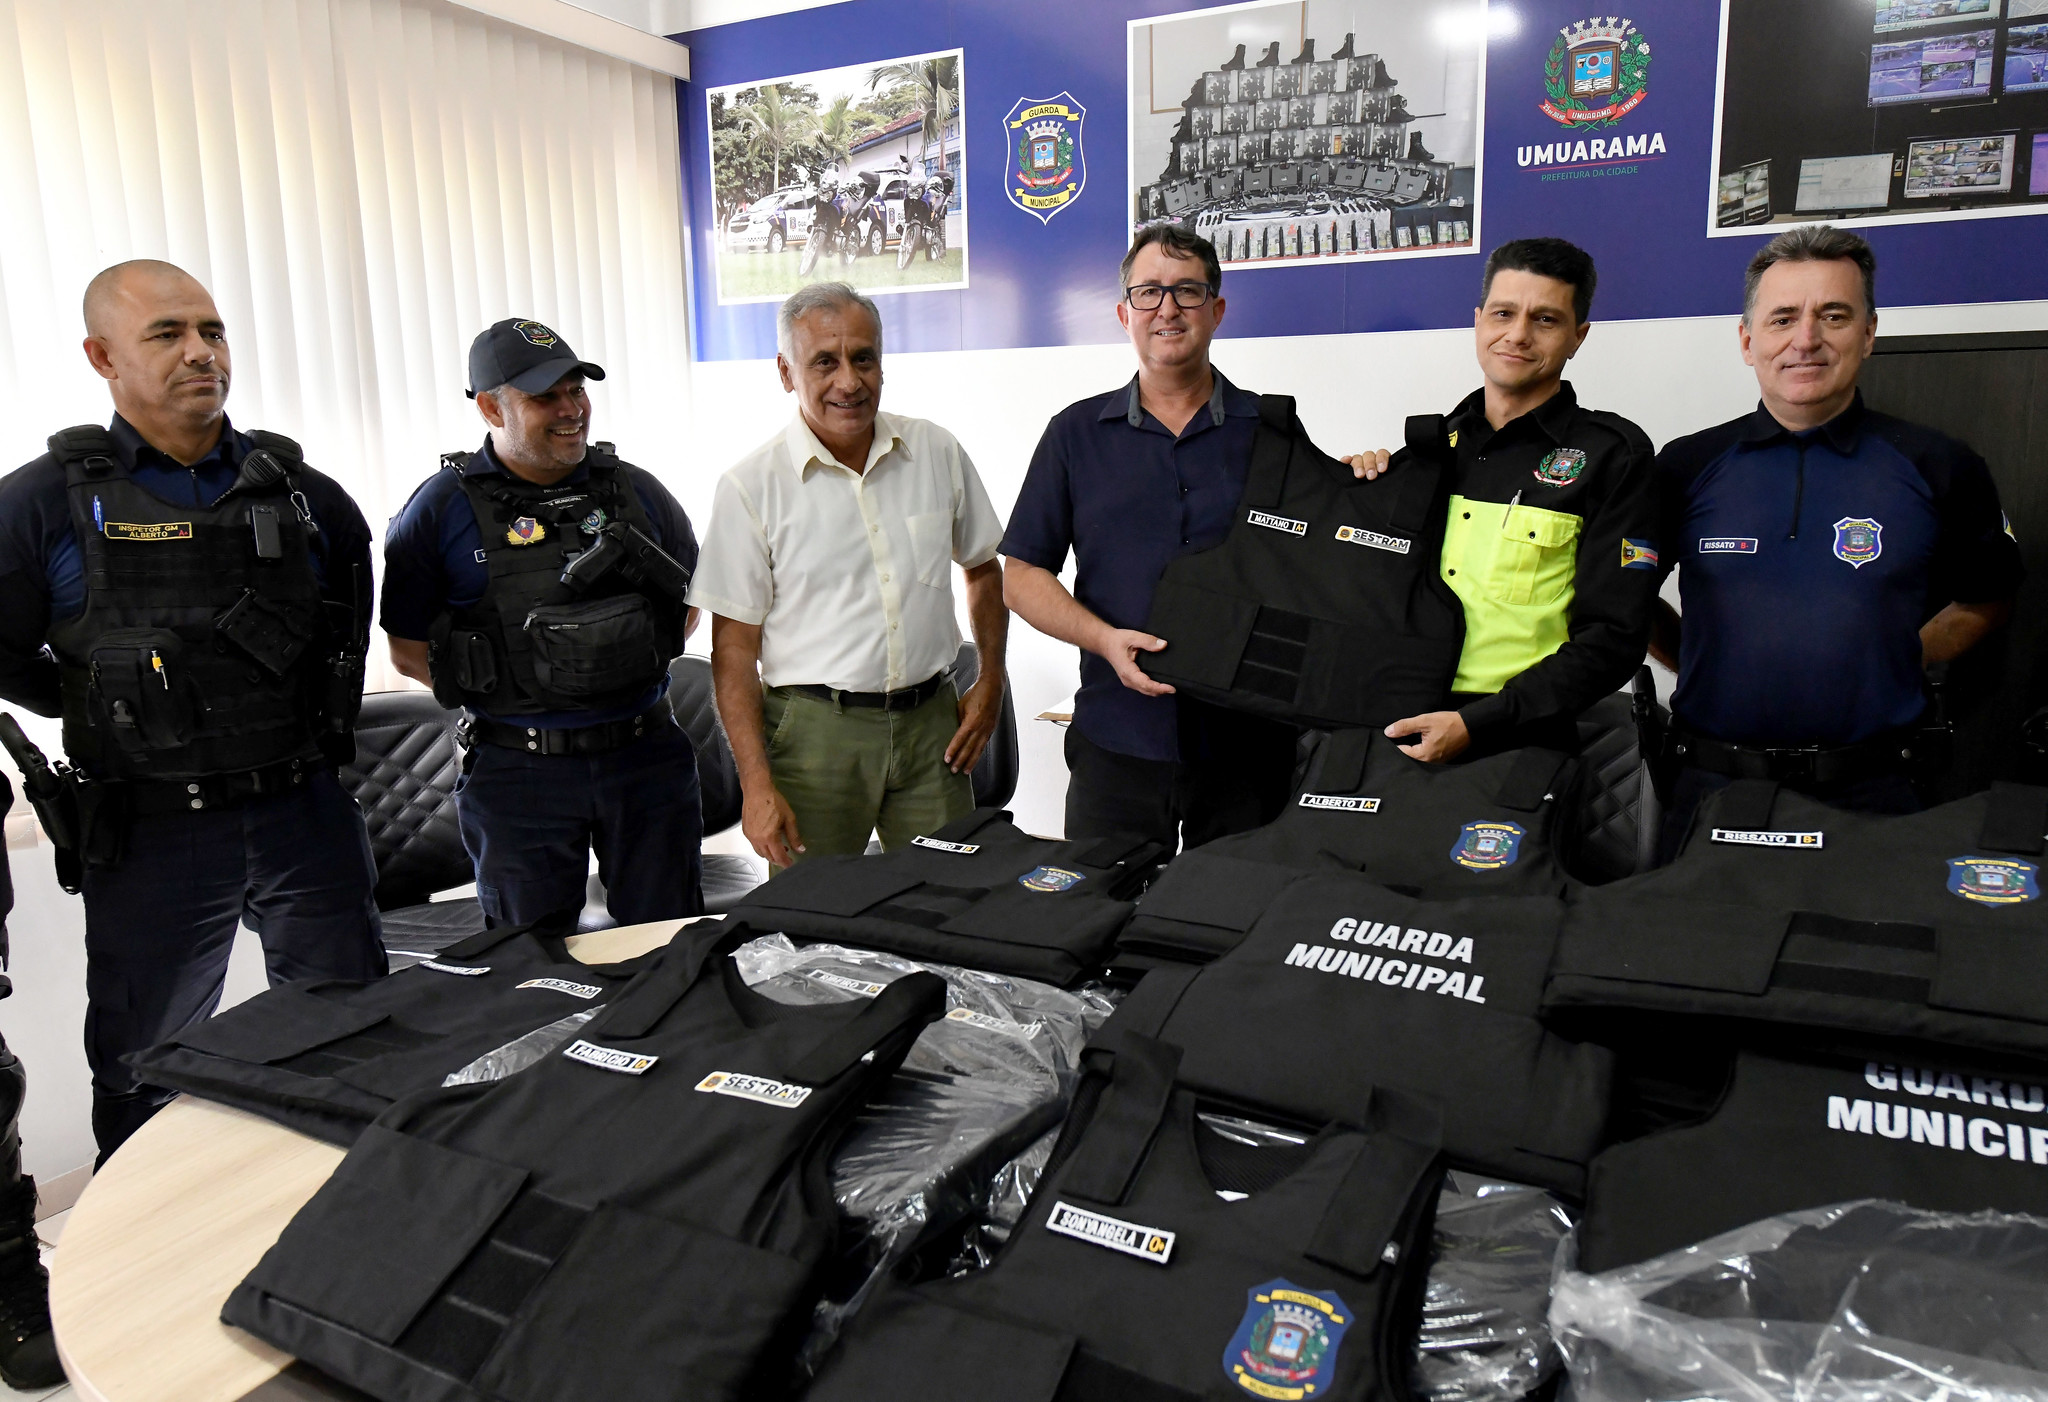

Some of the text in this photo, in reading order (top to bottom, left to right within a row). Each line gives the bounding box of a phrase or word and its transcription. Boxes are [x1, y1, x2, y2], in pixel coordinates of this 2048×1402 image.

[1621, 98, 1638, 112] 1960
[1029, 107, 1060, 118] GUARDA
[1571, 108, 1612, 119] UMUARAMA
[1517, 132, 1667, 167] UMUARAMA
[1541, 166, 1638, 182] PREFEITURA DA CIDADE
[1030, 196, 1061, 207] MUNICIPAL
[118, 525, 161, 533] INSPETOR
[1353, 530, 1409, 549] SESTRAM
[1704, 541, 1735, 549] RISSATO
[1308, 797, 1356, 808] ALBERTO
[1724, 832, 1788, 843] RISSATO
[1330, 917, 1473, 964] GUARDA
[1284, 943, 1486, 1004] MUNICIPAL
[724, 1075, 807, 1101] SESTRAM
